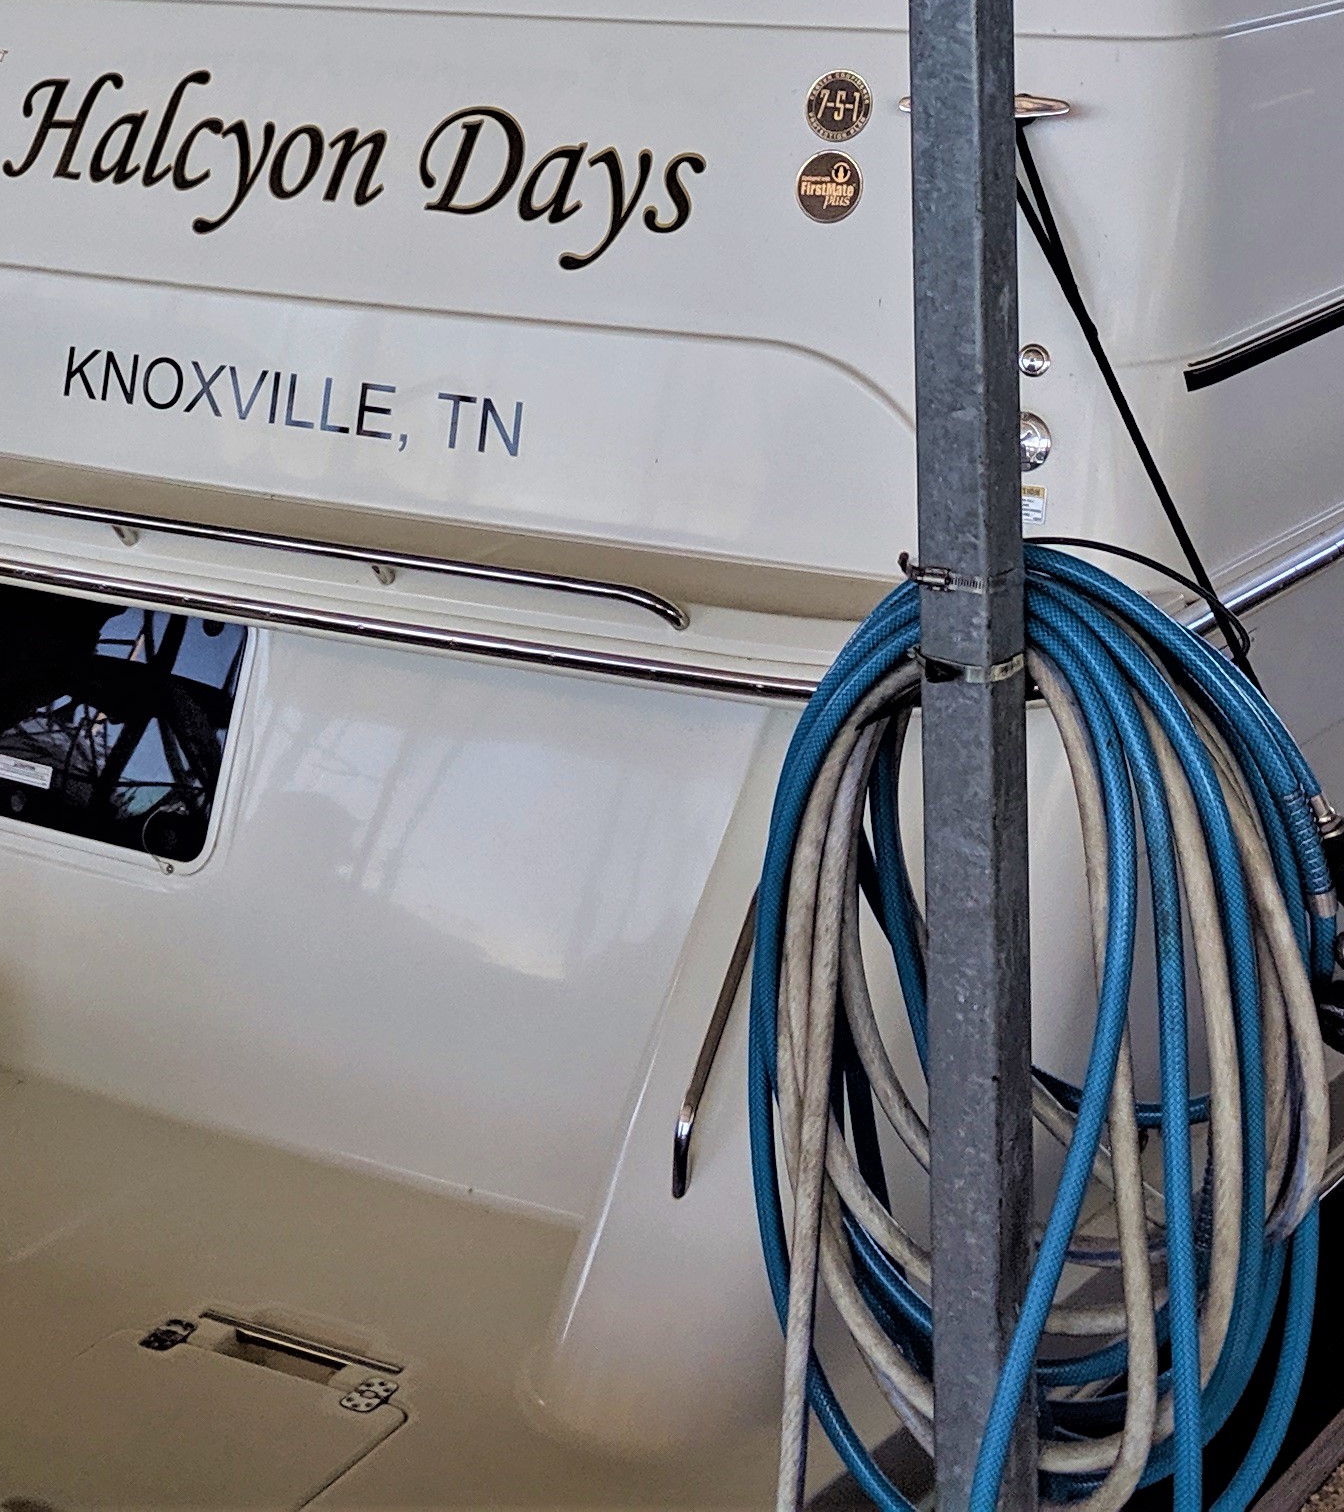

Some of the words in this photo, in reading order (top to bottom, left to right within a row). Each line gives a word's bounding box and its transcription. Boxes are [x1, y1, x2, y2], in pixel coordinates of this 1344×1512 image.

[817, 88, 861, 122] 7-5-1
[2, 69, 388, 235] Halcyon
[419, 105, 706, 270] Days
[63, 345, 408, 452] KNOXVILLE,
[438, 391, 523, 457] TN
